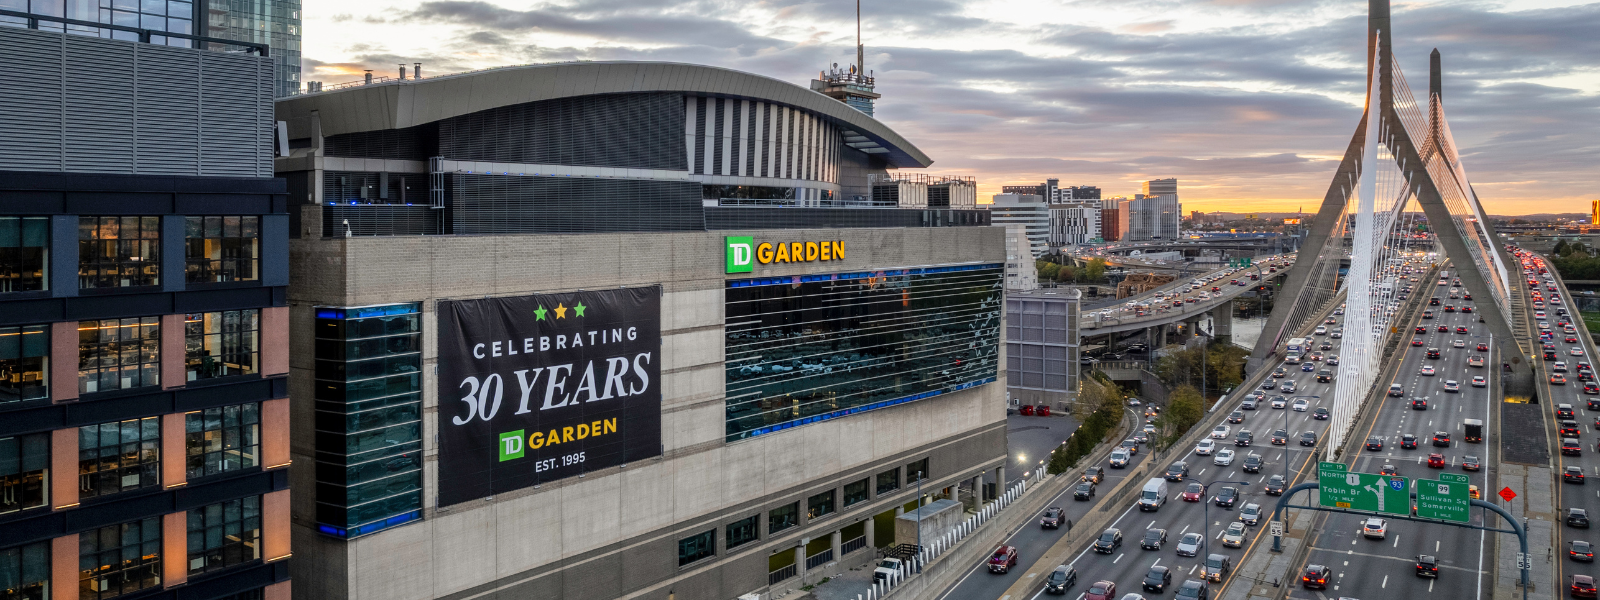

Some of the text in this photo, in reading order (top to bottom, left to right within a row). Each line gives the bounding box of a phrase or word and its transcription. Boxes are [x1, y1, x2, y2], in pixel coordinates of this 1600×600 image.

[729, 240, 845, 266] TD GARDEN
[473, 326, 638, 360] CELEBRATING
[452, 352, 652, 426] 30 YEARS
[502, 417, 617, 455] TD GARDEN
[535, 452, 586, 473] EST. 1995
[1321, 471, 1345, 479] NORTH
[1322, 486, 1346, 494] Tobin
[1392, 481, 1402, 489] 93
[1420, 494, 1452, 502] Sullivan
[1422, 502, 1465, 512] Somerville
